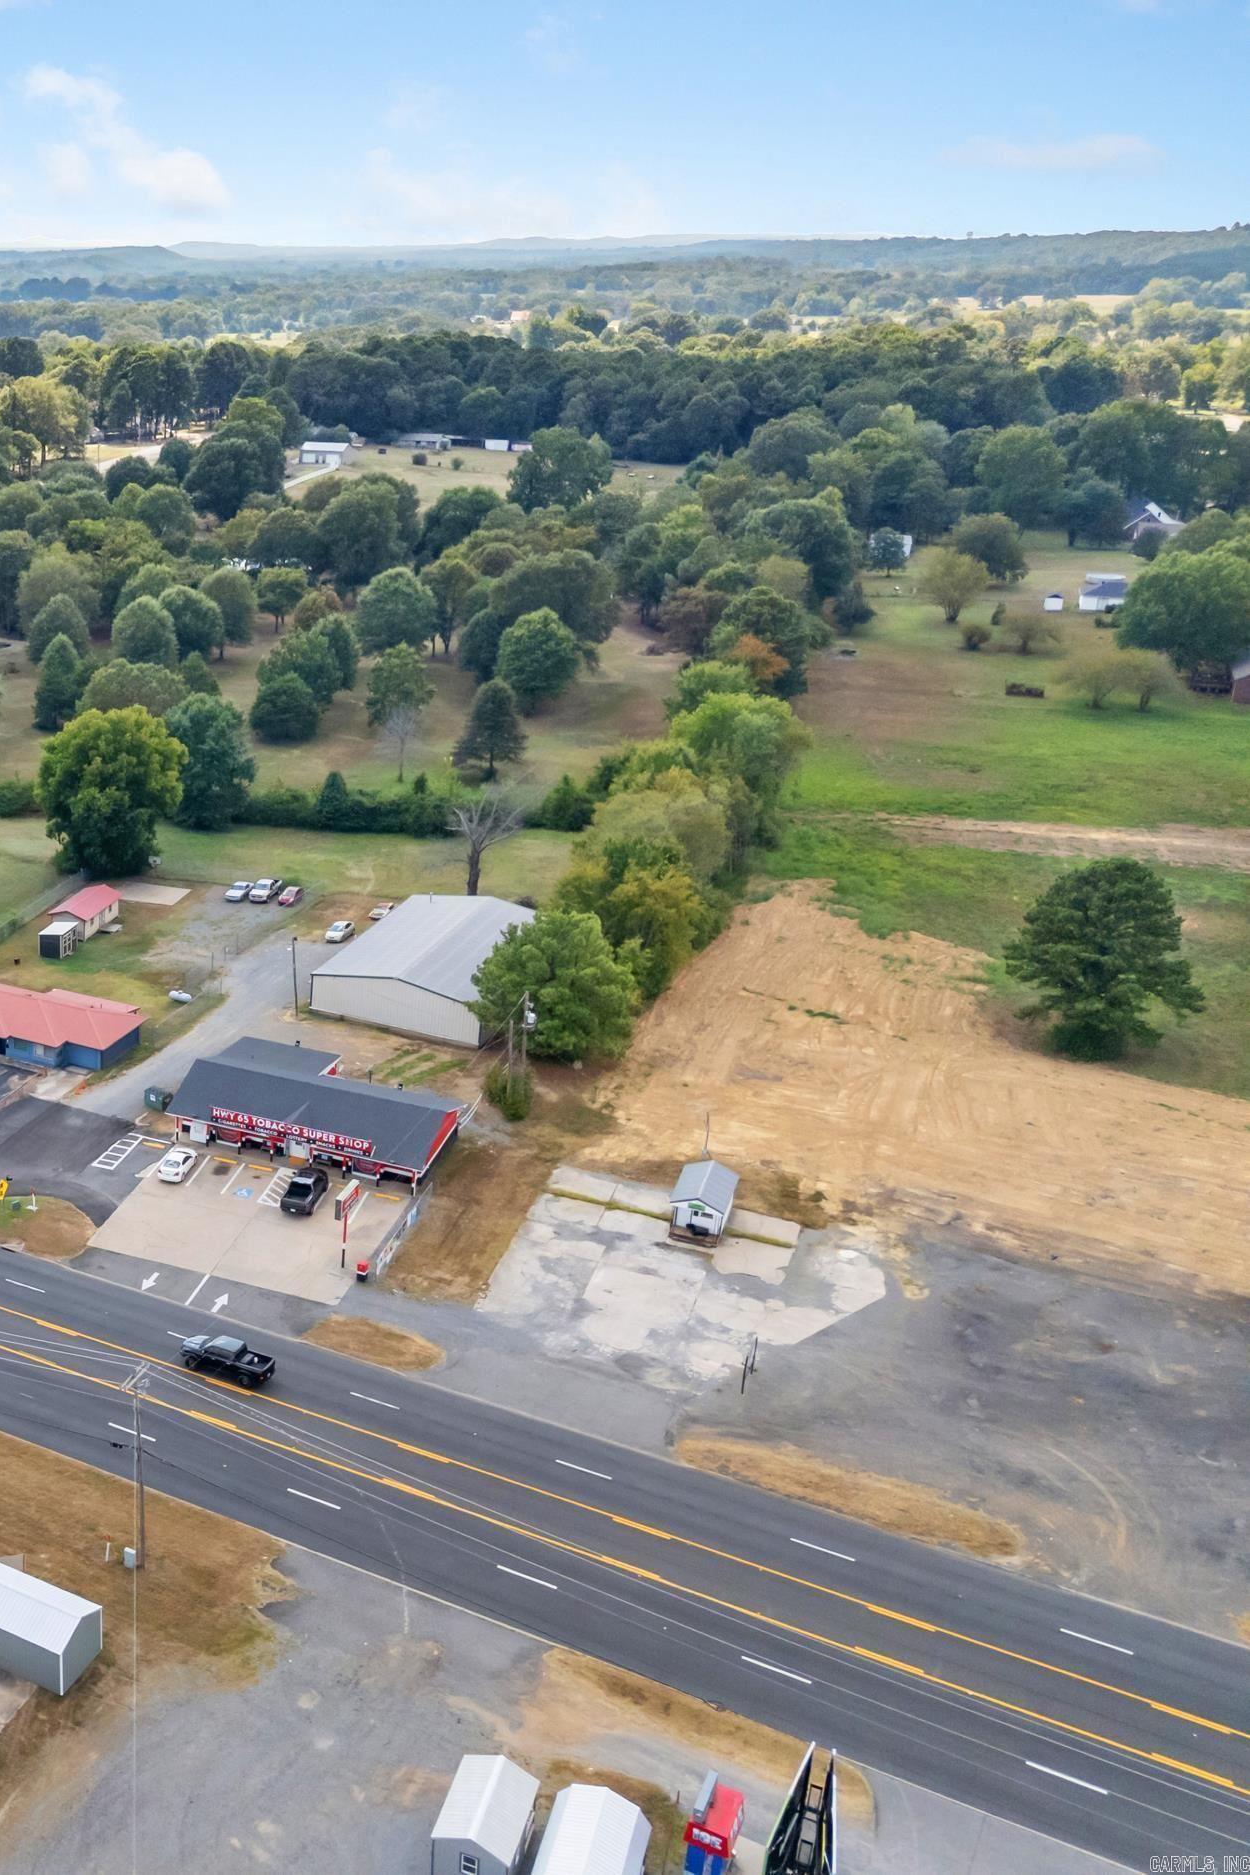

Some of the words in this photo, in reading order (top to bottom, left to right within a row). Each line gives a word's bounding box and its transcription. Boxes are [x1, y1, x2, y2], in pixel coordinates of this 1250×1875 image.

[212, 1108, 236, 1120] HWY
[237, 1114, 250, 1123] 65
[251, 1117, 300, 1135] TOBACCO
[302, 1128, 336, 1143] SUPER
[338, 1136, 370, 1149] SHOP
